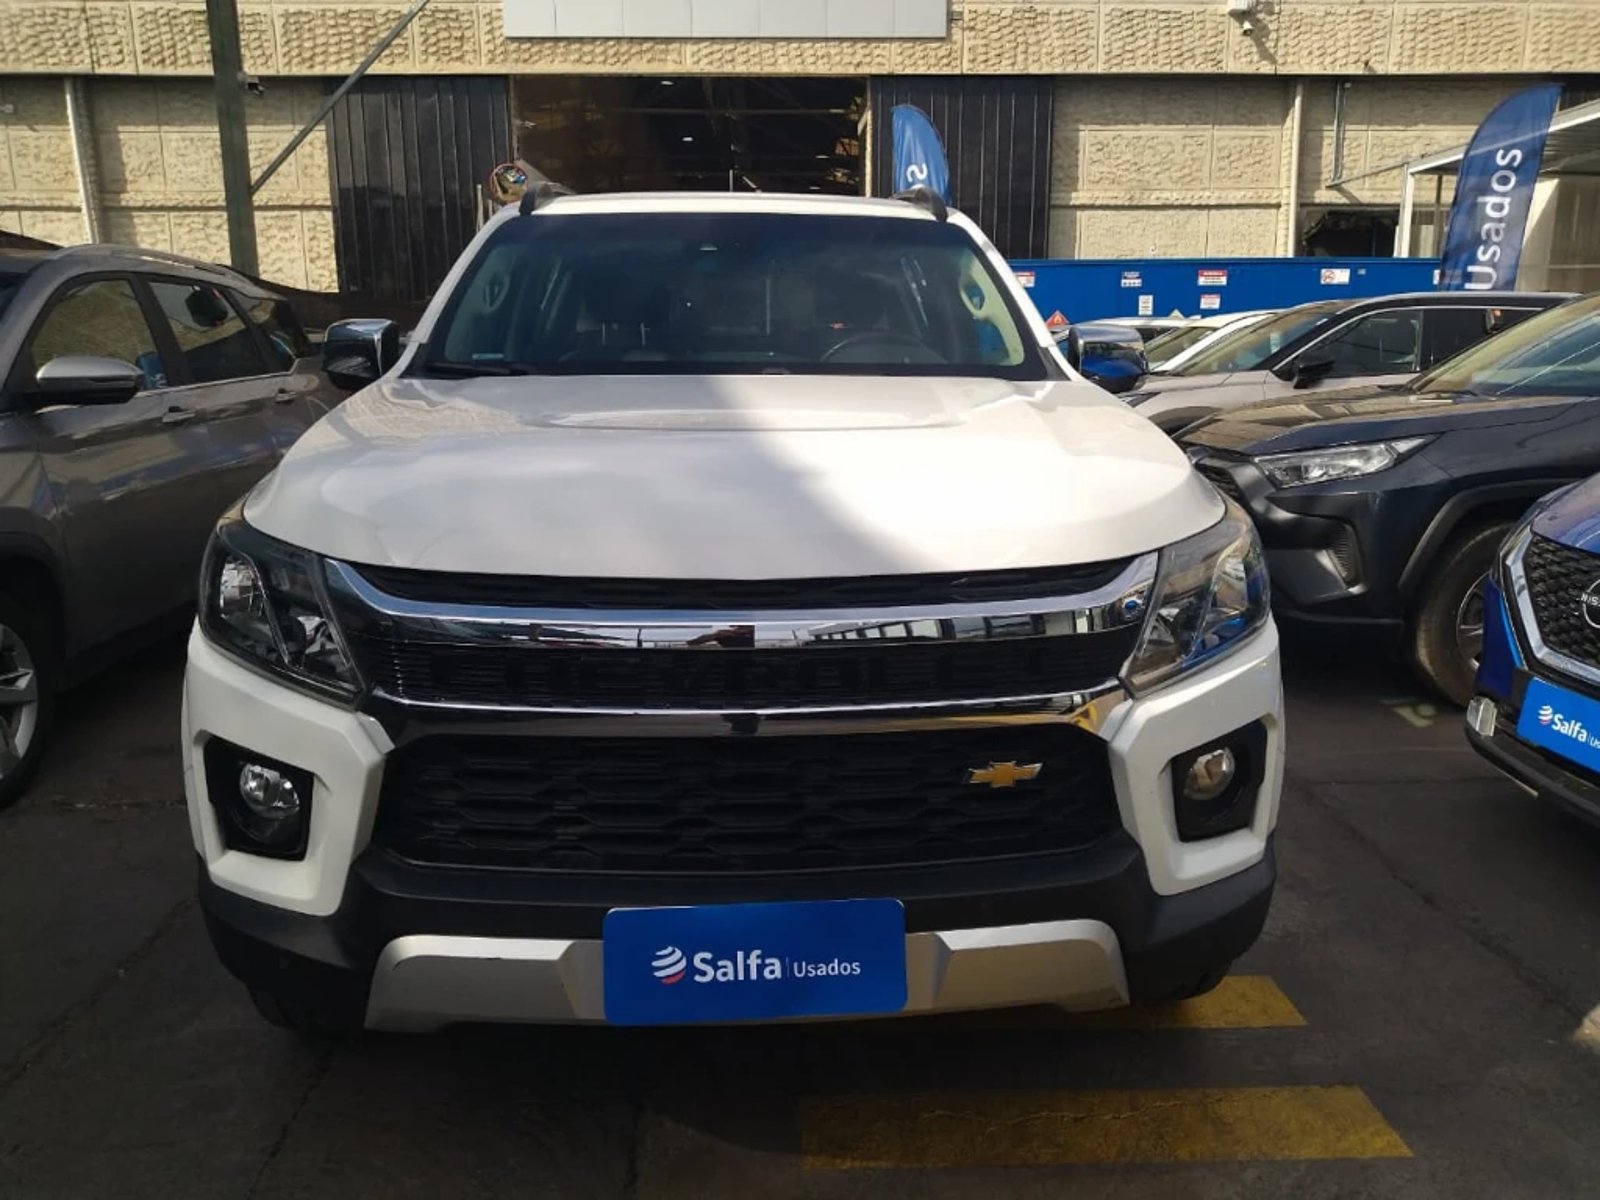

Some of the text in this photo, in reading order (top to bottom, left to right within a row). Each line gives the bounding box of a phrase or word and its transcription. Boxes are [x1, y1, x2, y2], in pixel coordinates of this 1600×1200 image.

[1464, 148, 1523, 290] Usados
[1581, 591, 1600, 607] NIS
[1551, 713, 1588, 743] Salfa
[693, 949, 861, 983] Salfa Usados
